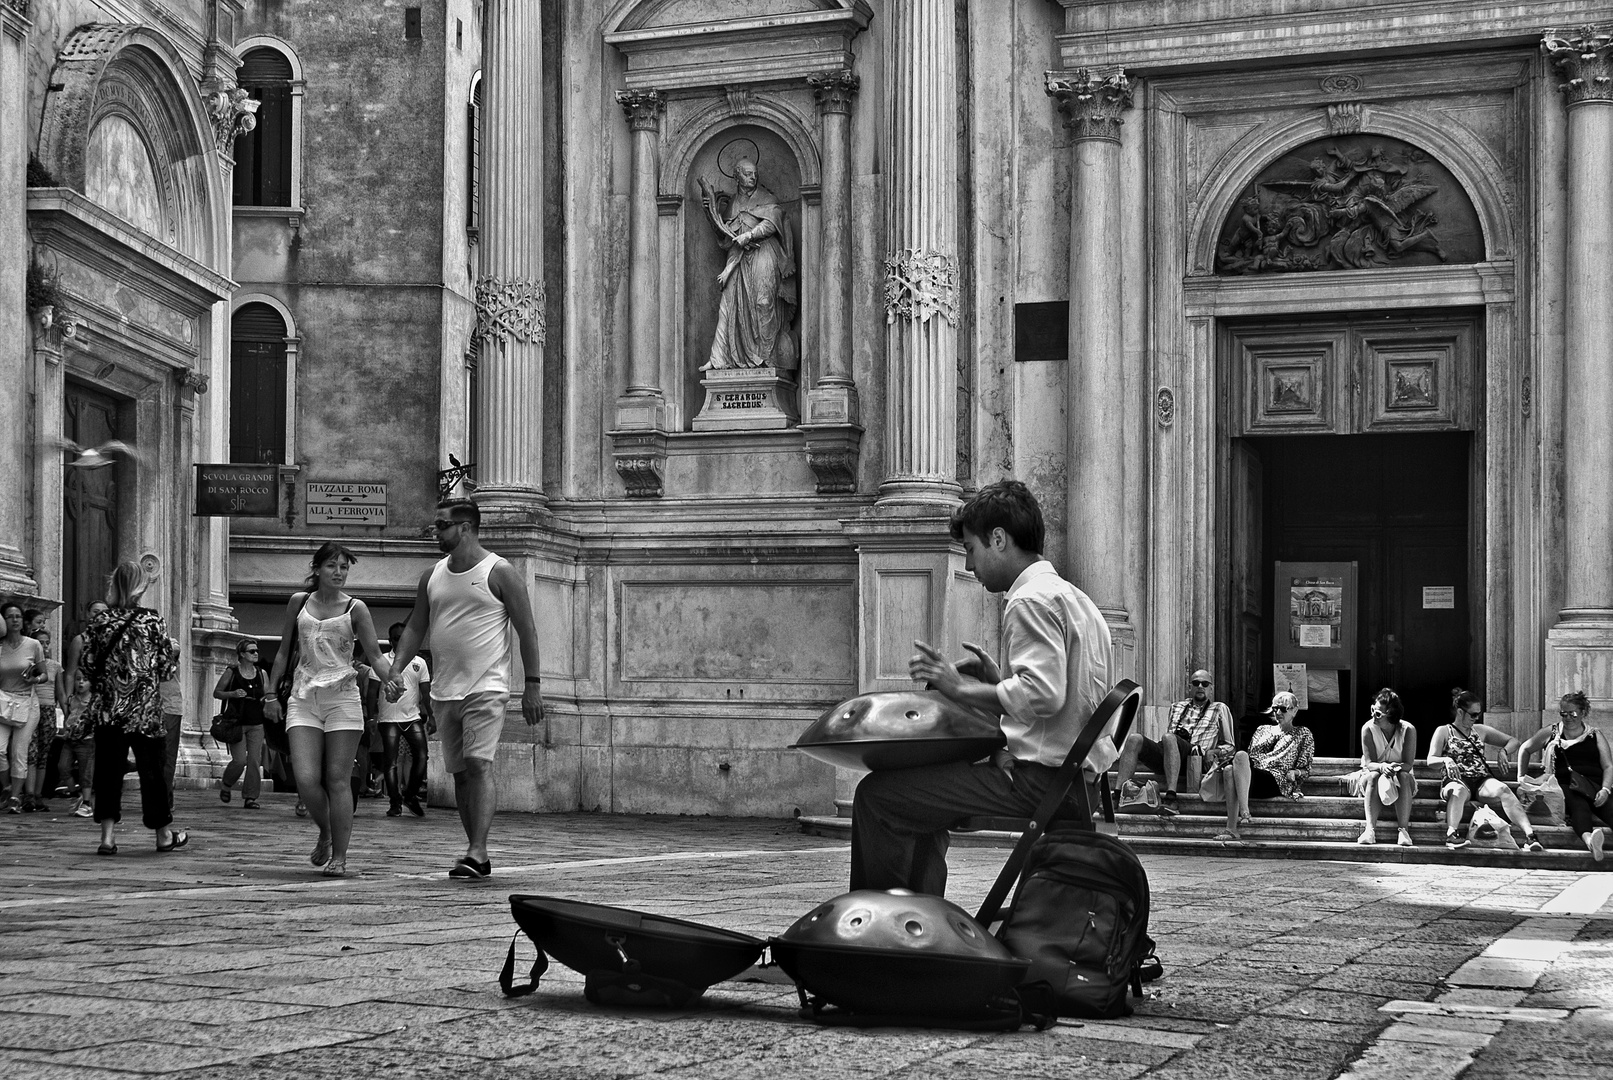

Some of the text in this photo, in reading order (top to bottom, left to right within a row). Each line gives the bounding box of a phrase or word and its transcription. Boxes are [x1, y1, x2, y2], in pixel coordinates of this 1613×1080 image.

[202, 473, 274, 482] SCVOLA GRANDE
[208, 486, 269, 495] DI SAN ROCCO
[309, 484, 385, 494] PIAZZALE ROMA
[309, 506, 385, 516] ALLA FERROVIA
